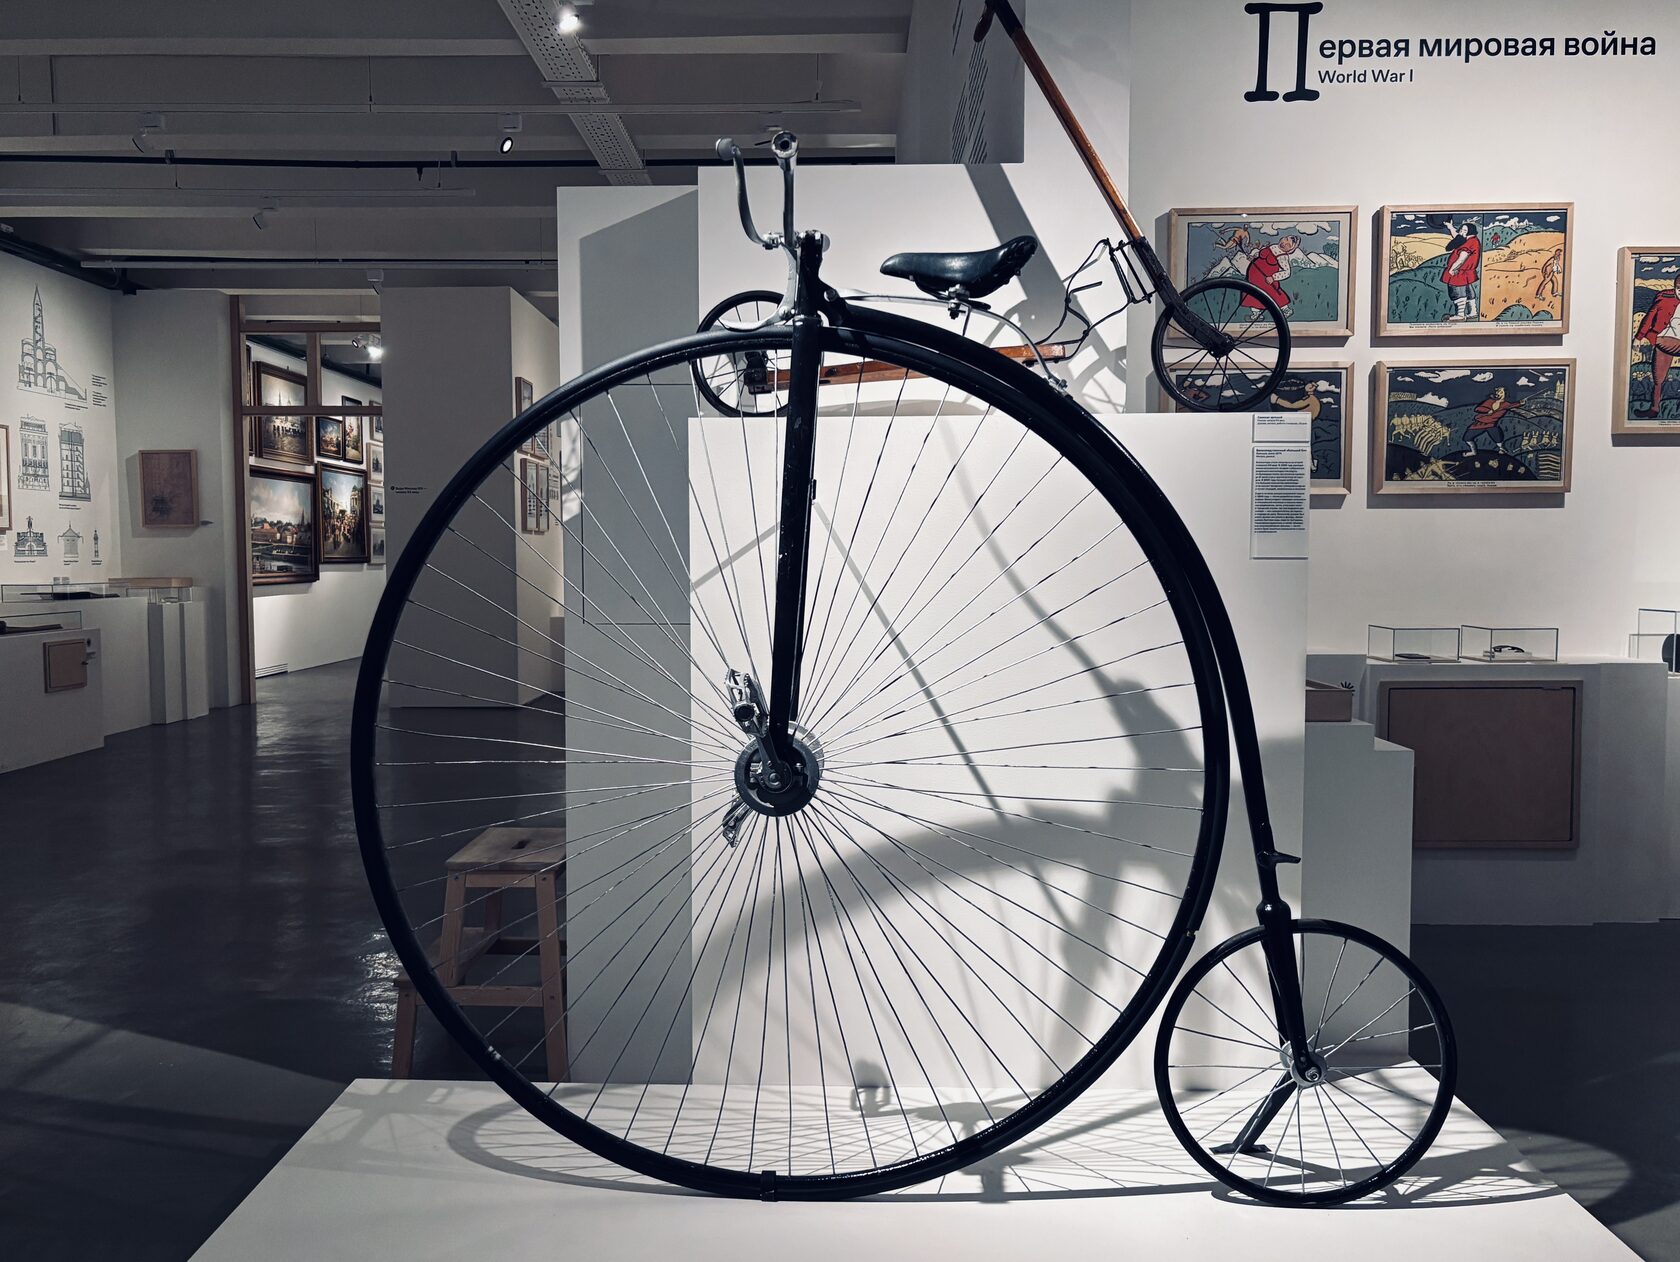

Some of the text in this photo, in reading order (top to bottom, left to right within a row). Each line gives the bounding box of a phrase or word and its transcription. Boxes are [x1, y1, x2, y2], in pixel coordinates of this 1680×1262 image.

[1244, 2, 1656, 102] Первая мировая война
[1318, 69, 1367, 84] World
[1372, 69, 1405, 83] War
